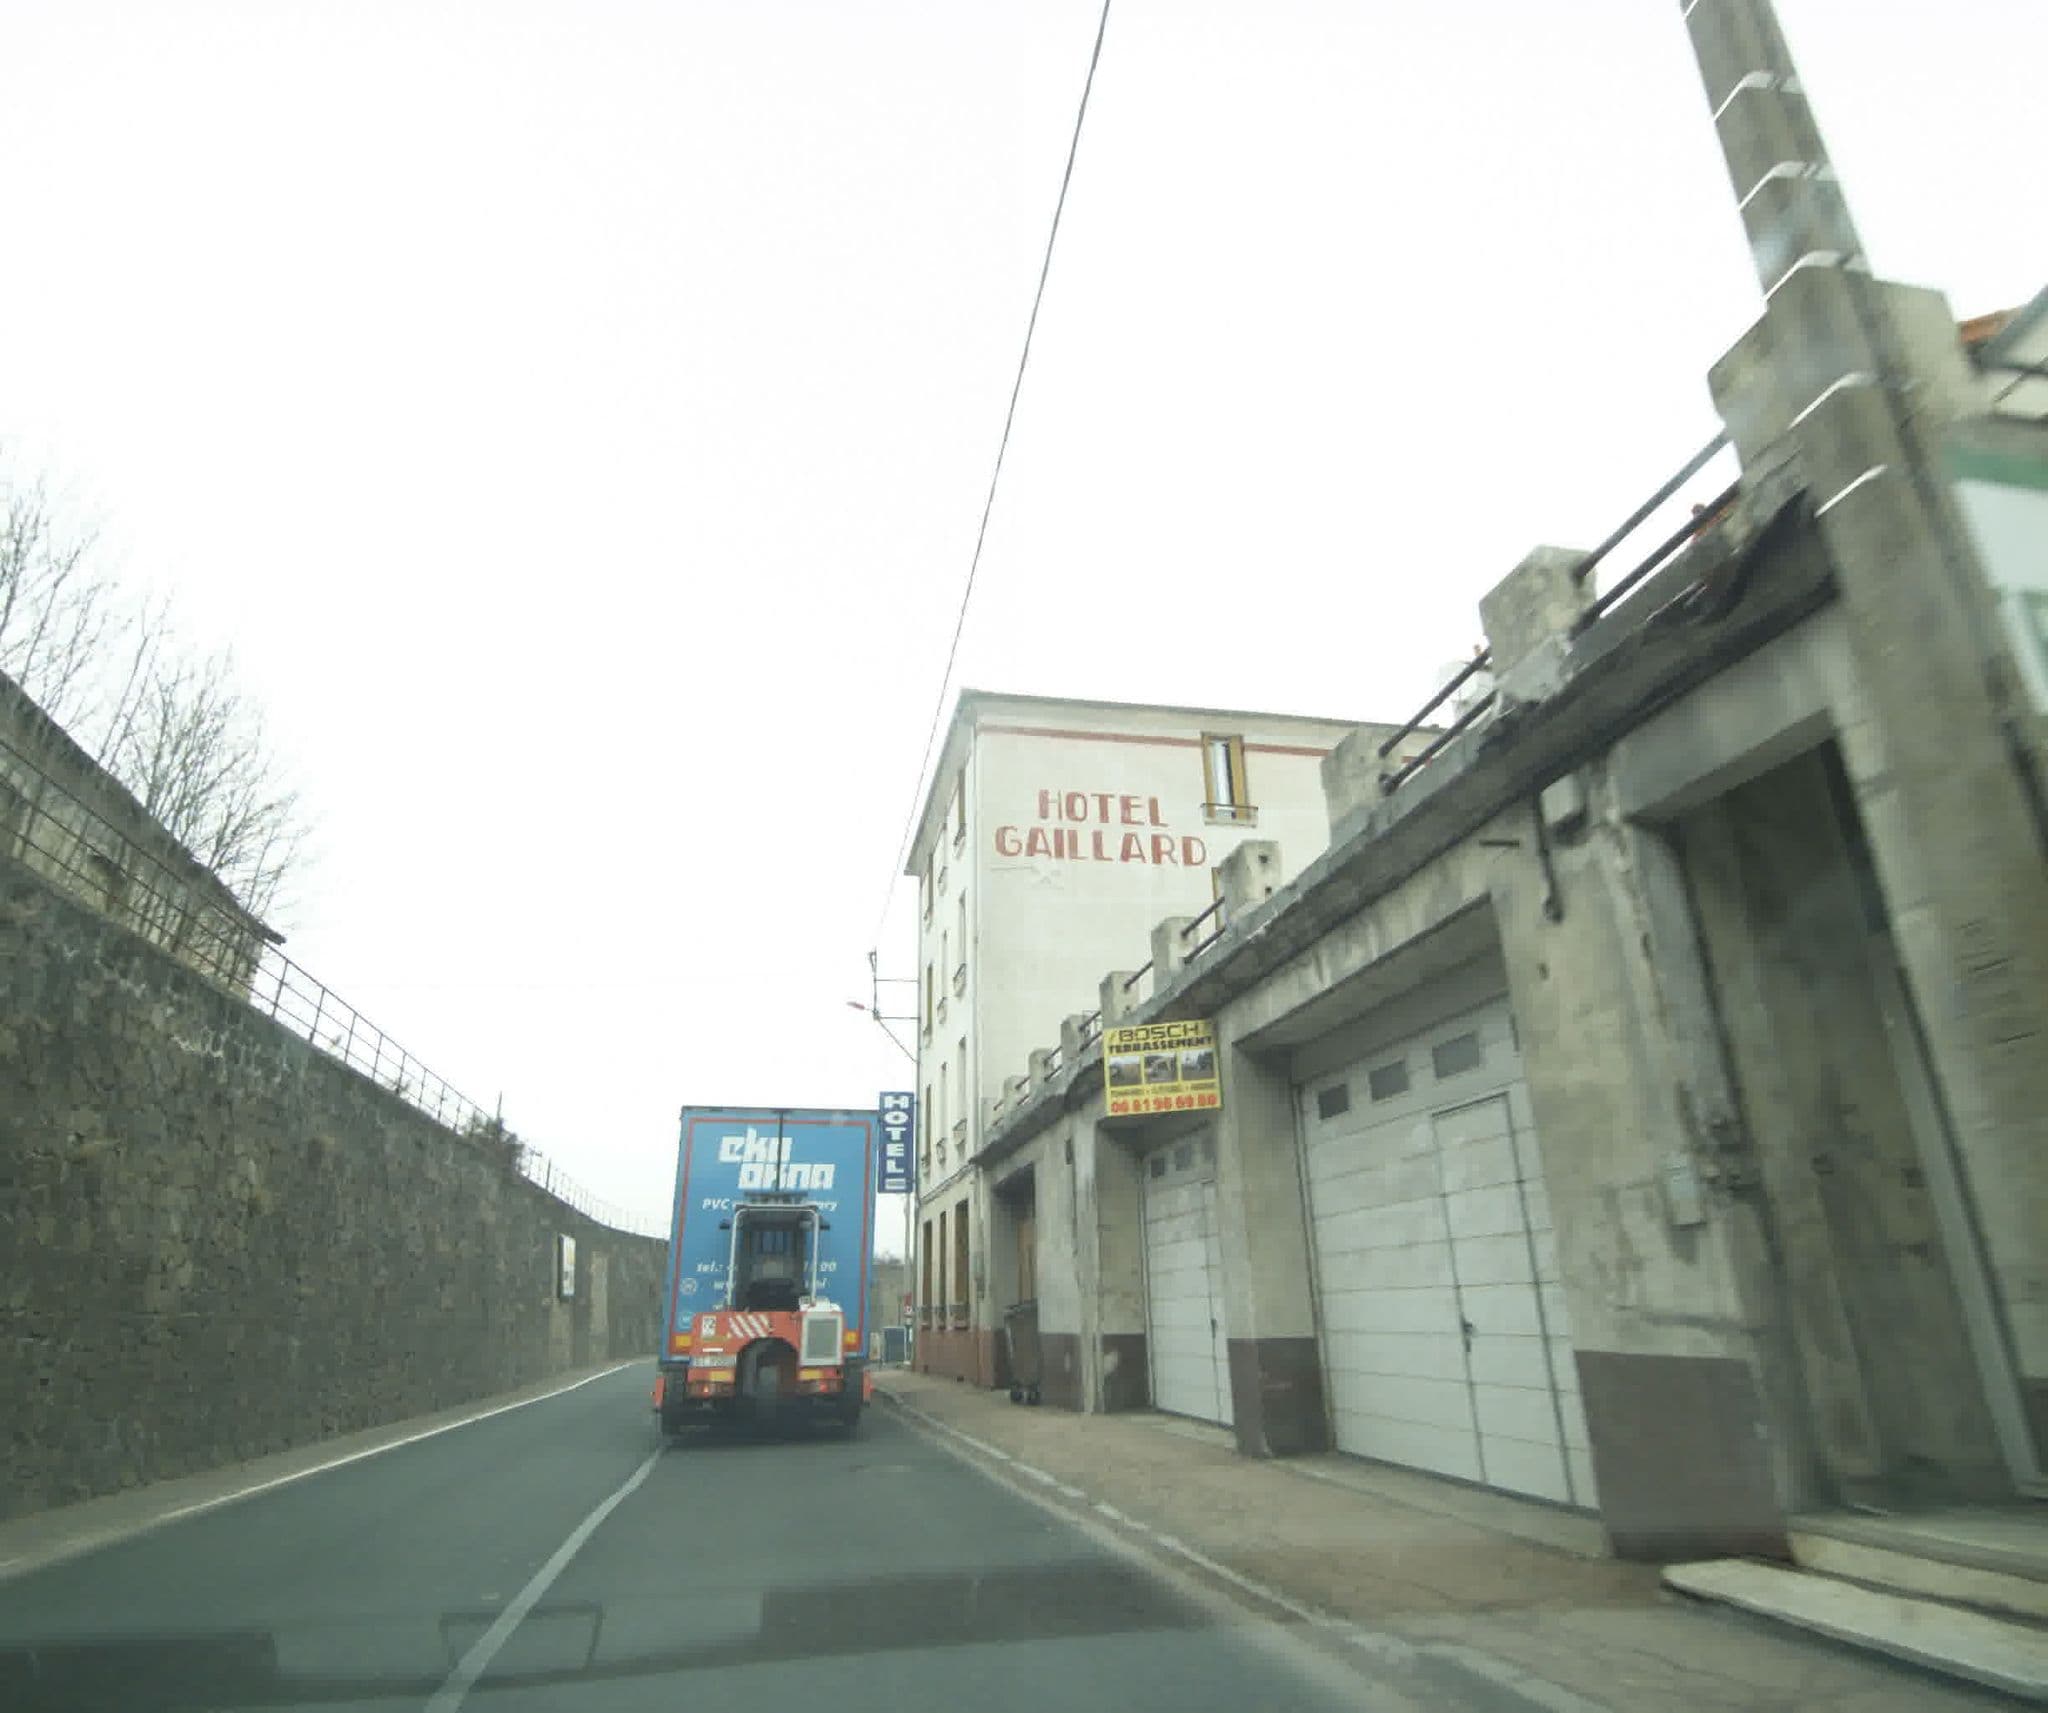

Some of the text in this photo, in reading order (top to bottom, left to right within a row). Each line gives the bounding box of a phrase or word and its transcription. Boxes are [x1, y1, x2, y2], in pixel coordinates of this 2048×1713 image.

[1038, 789, 1169, 828] HOTEL
[995, 826, 1207, 867] GAILLARD
[1109, 1036, 1212, 1054] TERRASSEMENT
[1119, 1023, 1199, 1042] BOSCH
[884, 1095, 910, 1174] HOTEL
[702, 1198, 730, 1210] PVC
